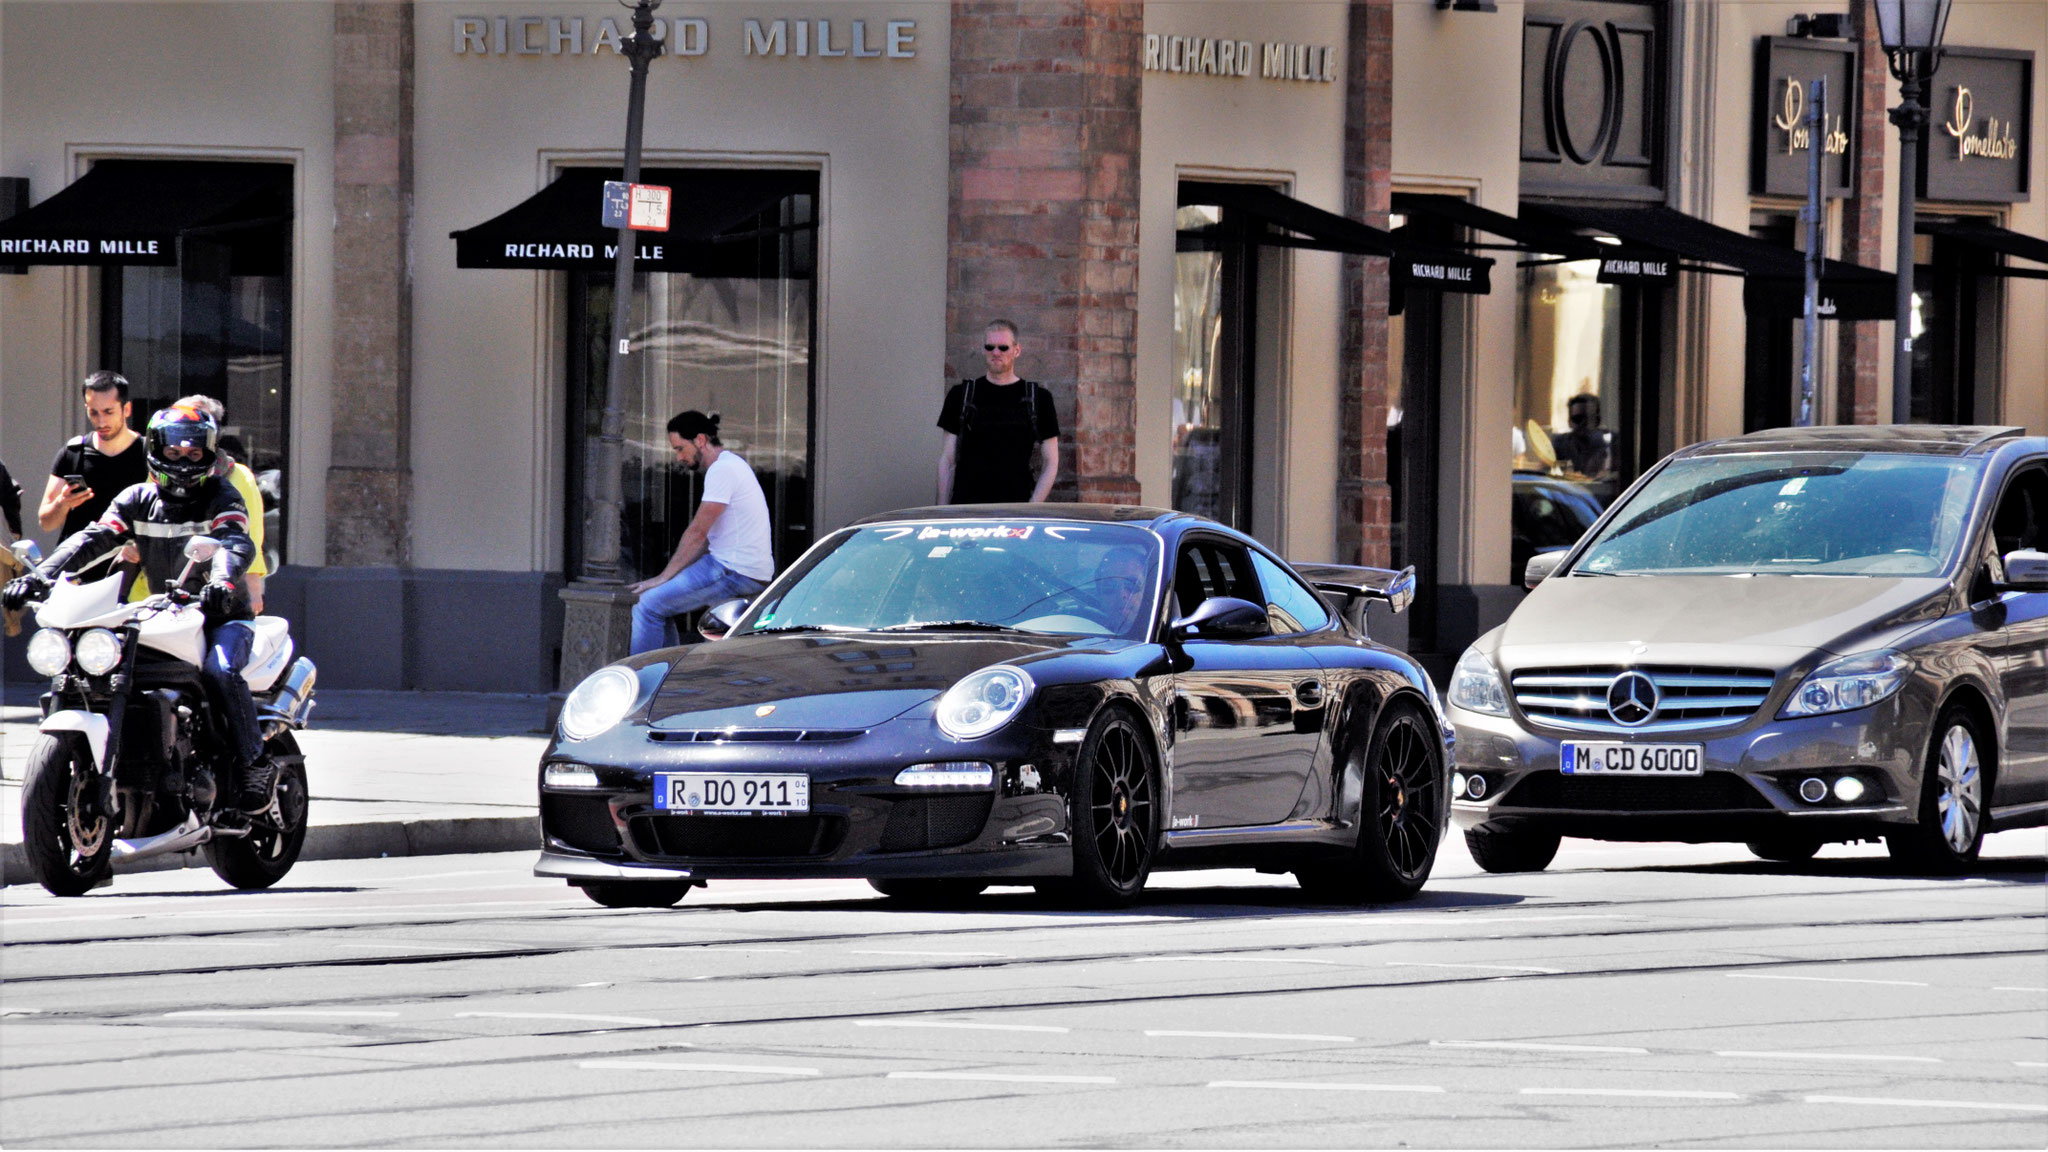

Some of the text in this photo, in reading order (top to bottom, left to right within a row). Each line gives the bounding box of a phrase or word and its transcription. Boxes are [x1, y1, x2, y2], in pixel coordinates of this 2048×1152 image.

[744, 19, 917, 58] MILLE
[1144, 33, 1337, 82] RICHARD MILLE
[1776, 75, 1849, 156] Pomlato
[1946, 84, 2017, 161] Pomellato
[1, 239, 159, 254] RICHARD MILLE
[505, 243, 664, 260] RICHARD MLE
[1412, 263, 1472, 281] RICHARD MILLE
[1604, 259, 1667, 276] RICHARD MILLE
[1576, 748, 1698, 772] M CD 6000
[672, 780, 792, 806] R DO 911
[795, 780, 806, 788] 04
[657, 795, 664, 803] D
[796, 799, 806, 807] 10
